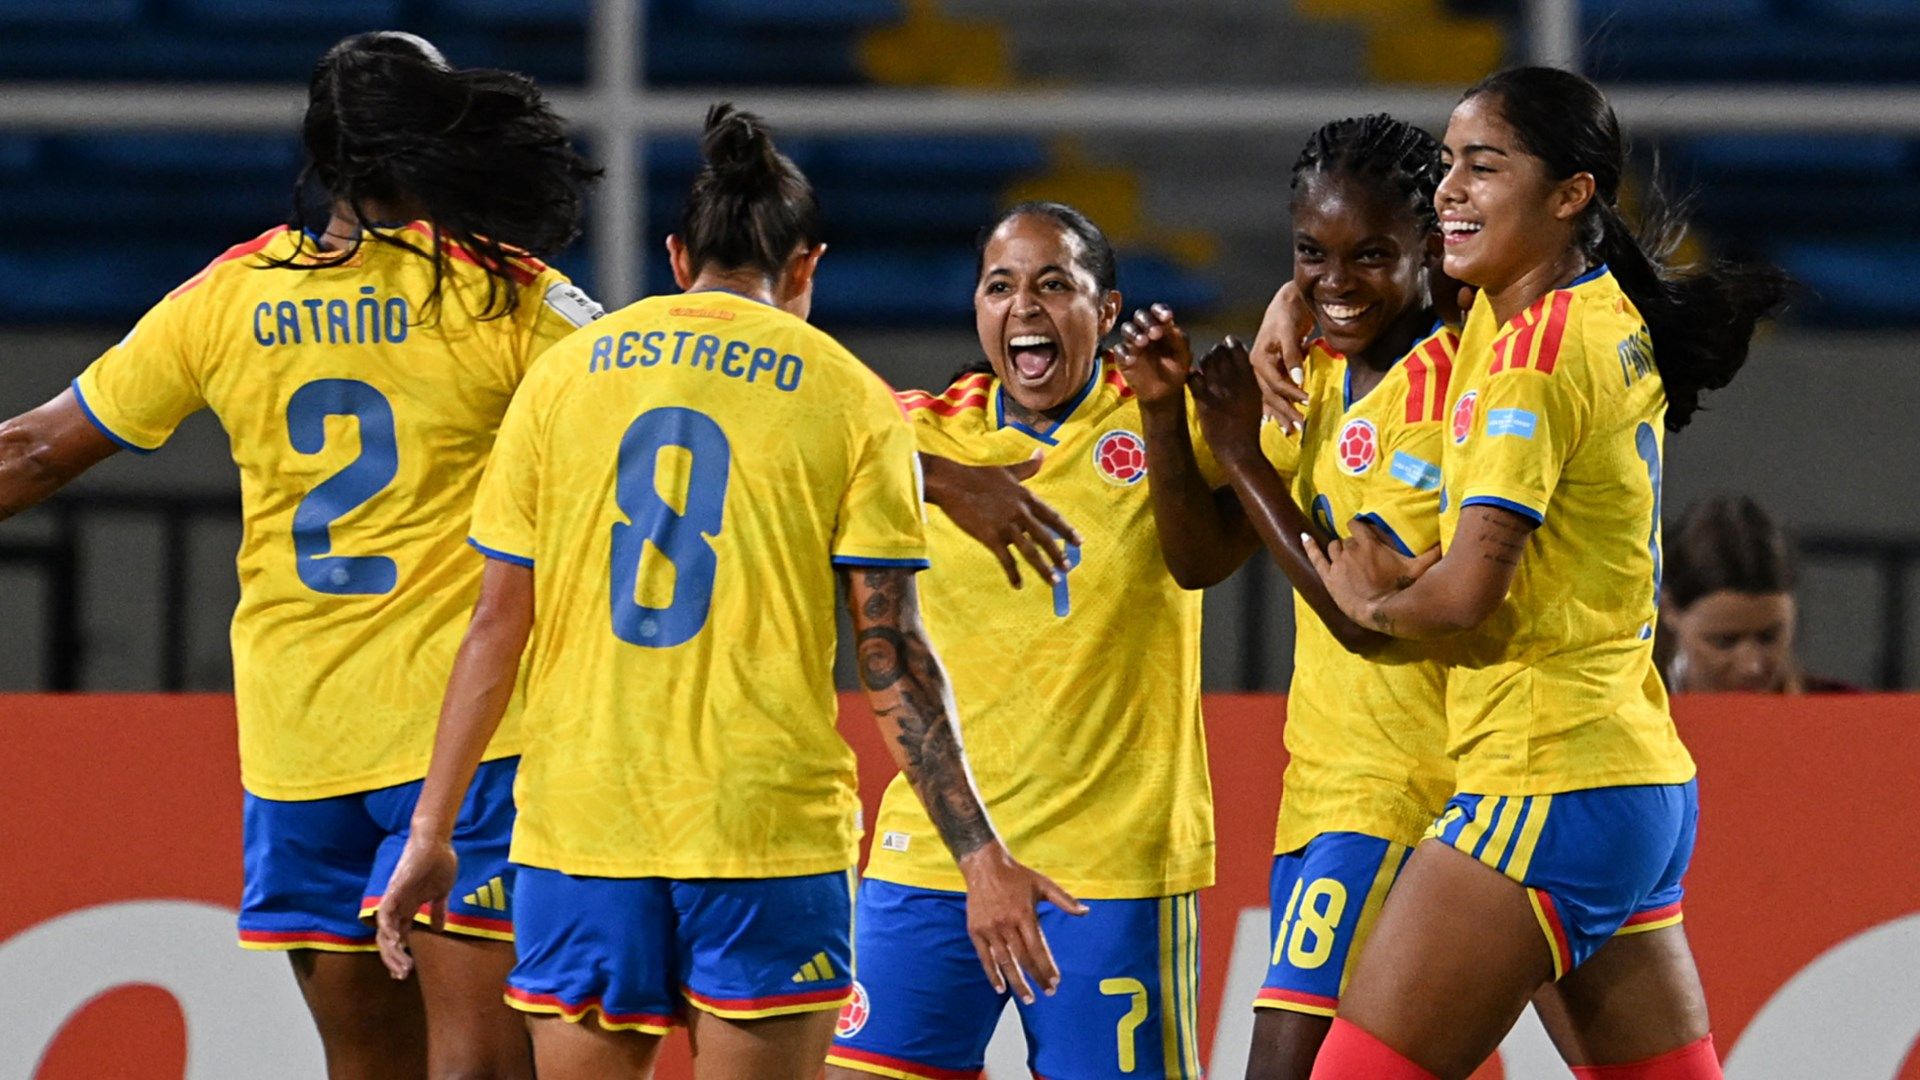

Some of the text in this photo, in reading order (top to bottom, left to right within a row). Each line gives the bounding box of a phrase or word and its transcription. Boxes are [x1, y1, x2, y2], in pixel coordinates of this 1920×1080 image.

[254, 286, 408, 346] CATAÑO
[589, 331, 803, 392] RESTREPO
[286, 378, 399, 594] 2
[610, 407, 731, 648] 8
[1272, 877, 1347, 970] 18
[1099, 977, 1147, 1072] 7
